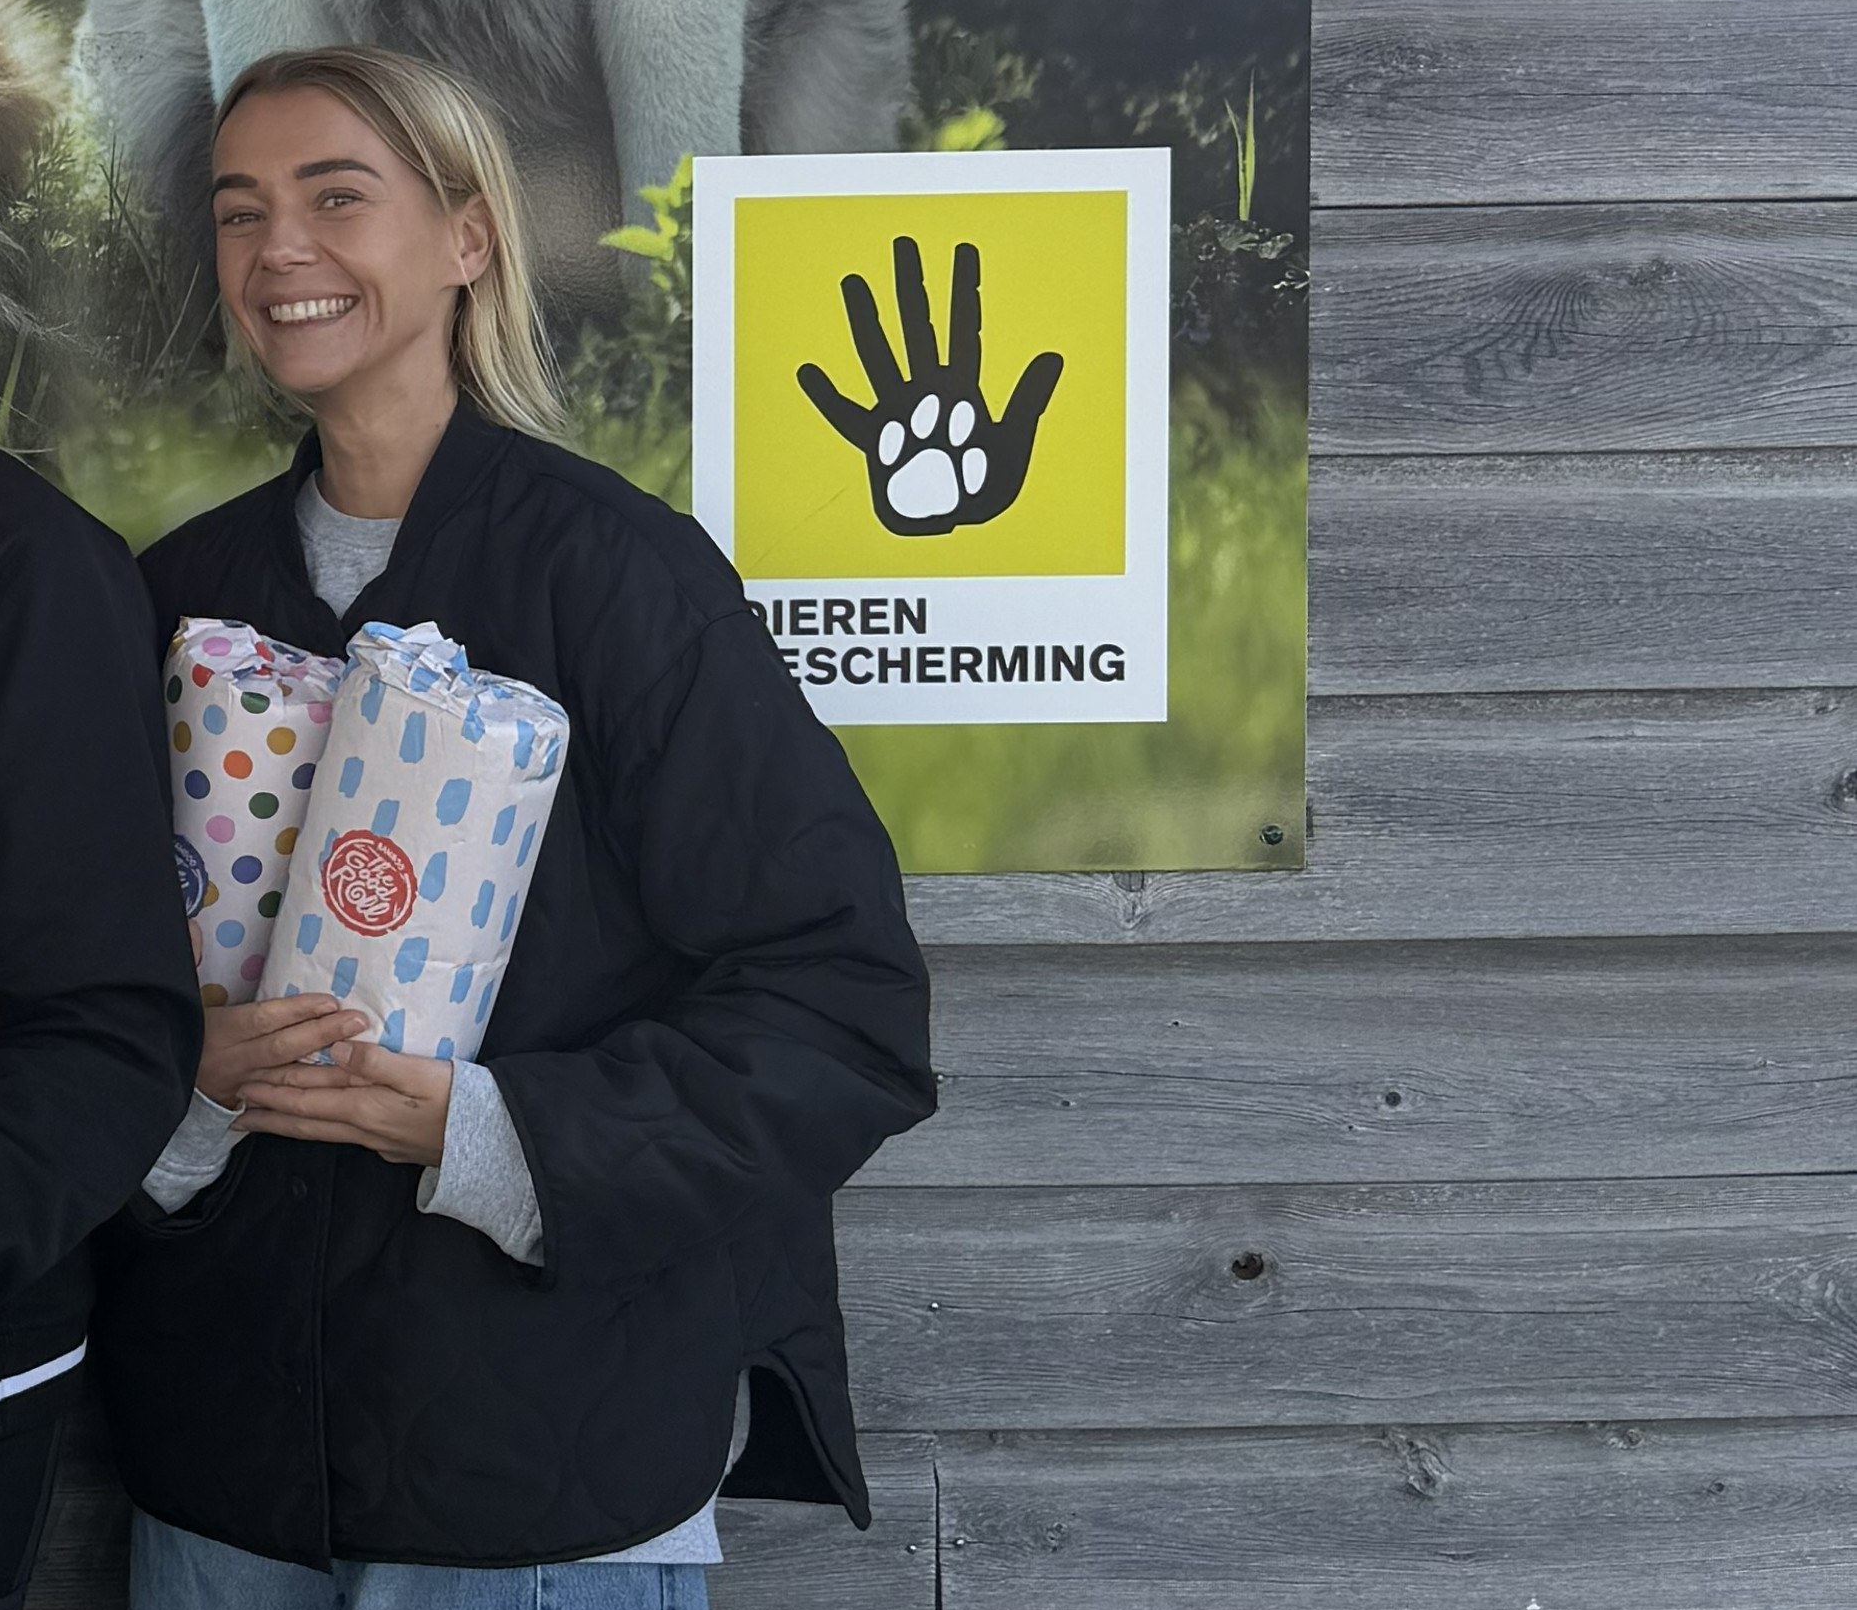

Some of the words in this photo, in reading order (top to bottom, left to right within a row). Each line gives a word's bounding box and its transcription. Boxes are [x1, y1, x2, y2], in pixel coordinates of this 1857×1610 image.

[778, 643, 1125, 685] ESCHERMING
[345, 850, 398, 901] Good
[366, 845, 398, 887] The
